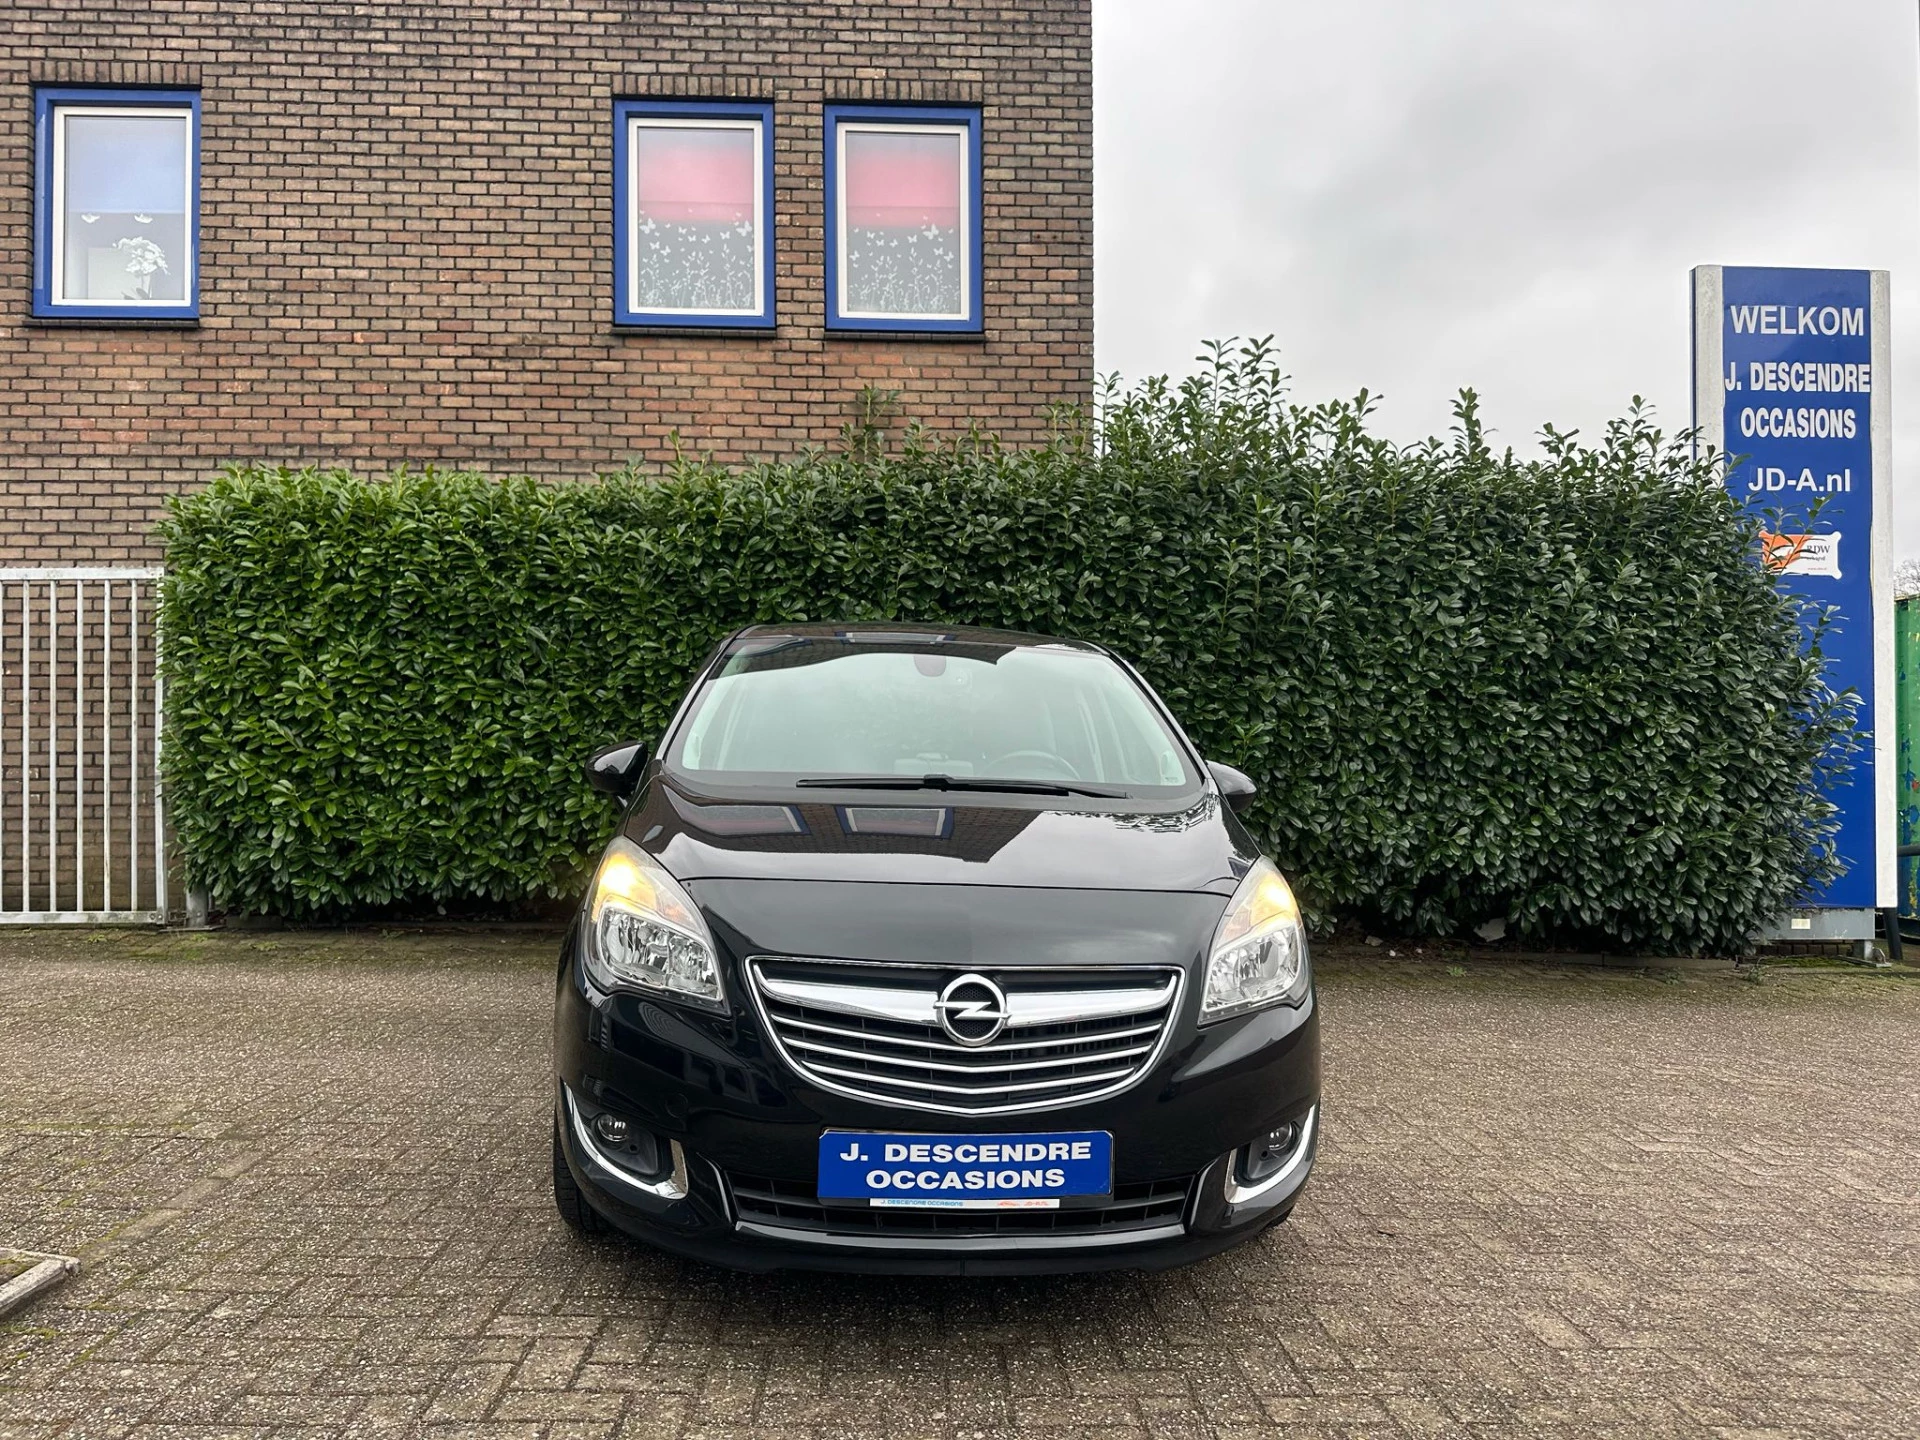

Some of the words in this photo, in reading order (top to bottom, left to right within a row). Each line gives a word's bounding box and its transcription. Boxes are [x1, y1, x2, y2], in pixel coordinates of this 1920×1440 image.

[1730, 305, 1864, 336] WELKOM
[1724, 362, 1742, 391] J.
[1750, 362, 1871, 393] DESCENDRE
[1740, 407, 1856, 439] OCCASIONS
[1748, 468, 1851, 492] JD-A.nl
[839, 1143, 868, 1161] J.
[884, 1141, 1092, 1163] DESCENDRE
[865, 1168, 1065, 1189] OCCASIONS
